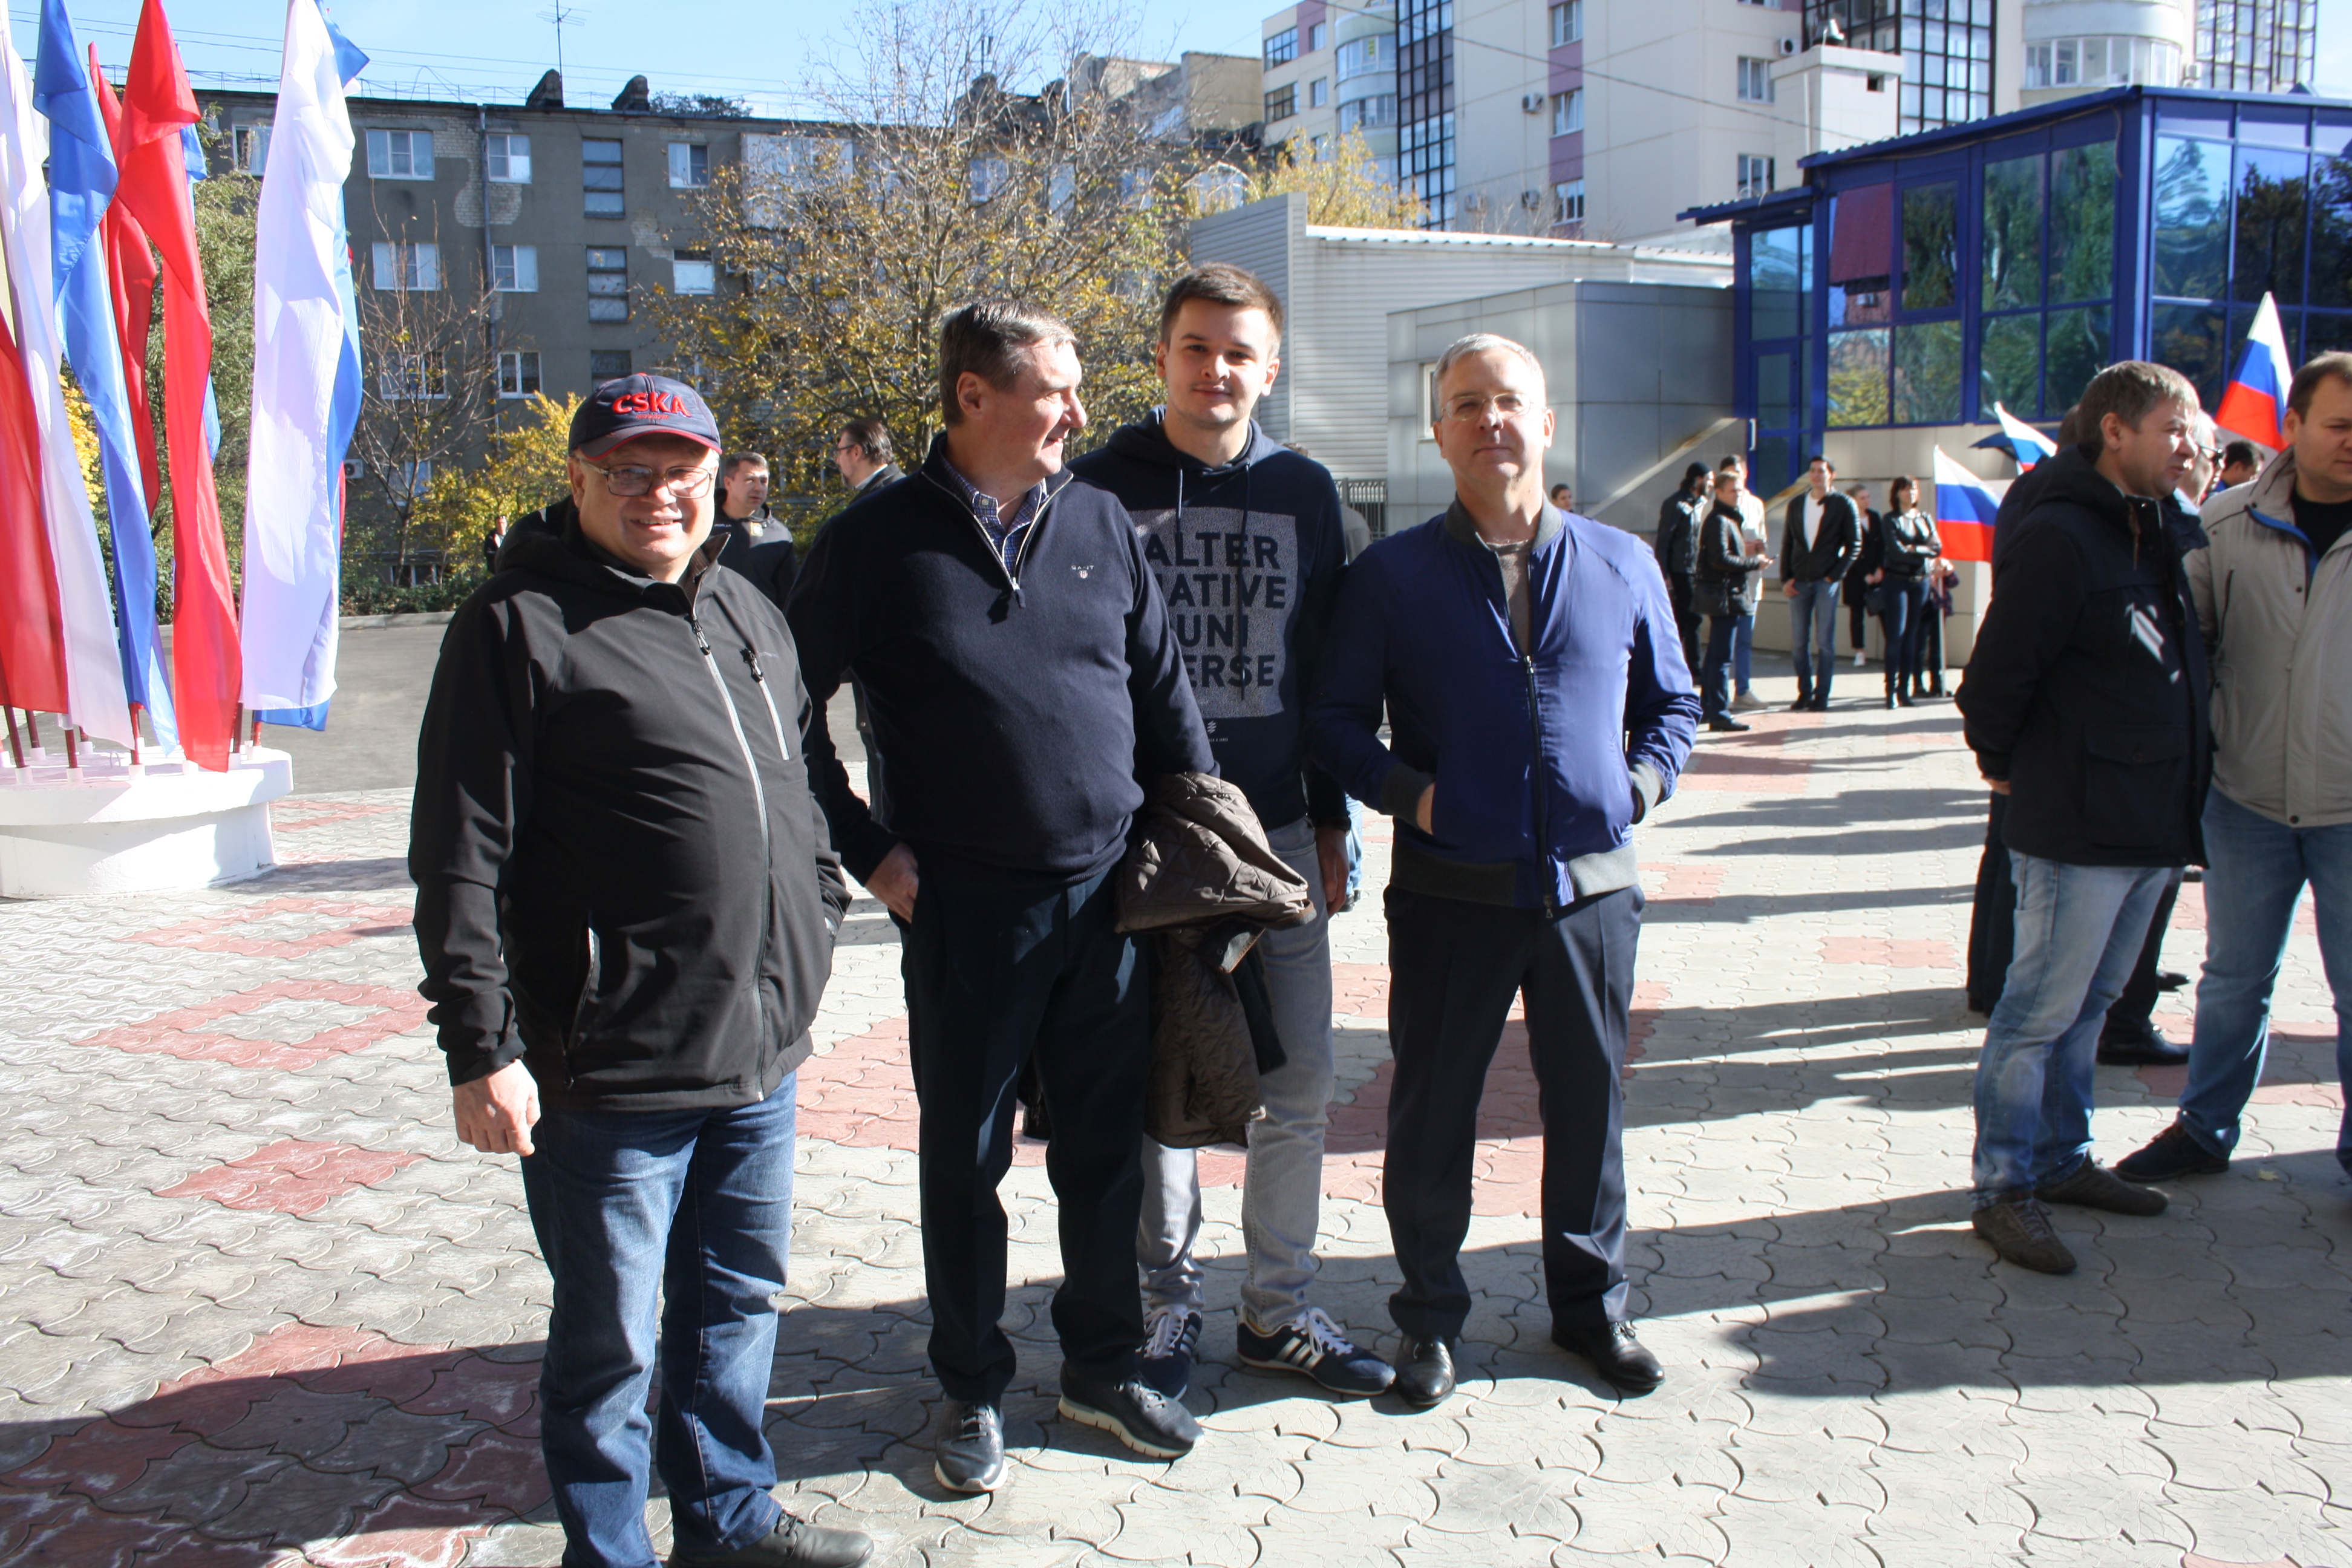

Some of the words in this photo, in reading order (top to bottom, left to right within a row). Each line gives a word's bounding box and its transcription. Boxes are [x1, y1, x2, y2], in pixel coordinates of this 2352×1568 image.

[612, 392, 691, 417] CSKA
[1145, 532, 1281, 569] ALTER
[1177, 614, 1249, 647] UNI
[1181, 654, 1275, 687] ERSE
